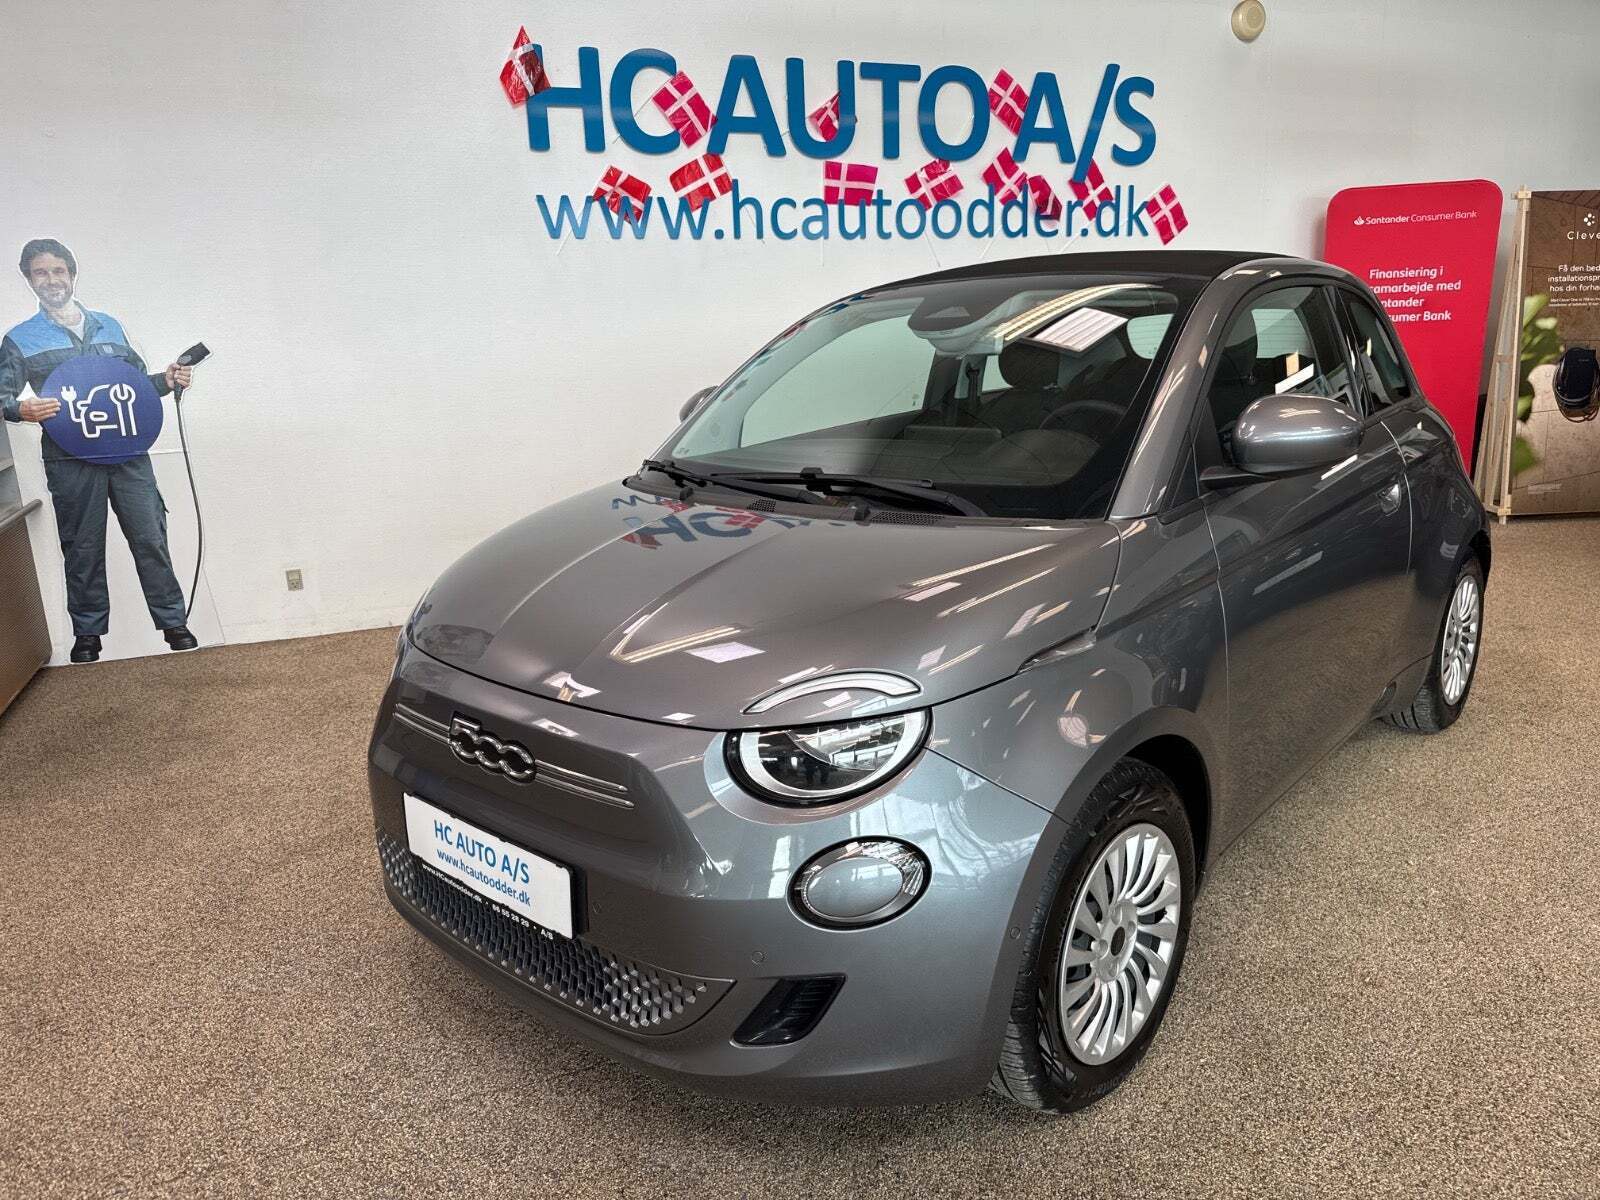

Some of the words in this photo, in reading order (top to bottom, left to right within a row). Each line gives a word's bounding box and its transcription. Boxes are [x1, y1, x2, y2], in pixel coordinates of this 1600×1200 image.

[525, 43, 681, 156] HC
[706, 54, 990, 162] AUTO
[1012, 63, 1157, 183] A/S
[536, 178, 1149, 240] www.hcautoodder.dk
[1365, 215, 1409, 226] Santander
[1410, 212, 1454, 223] Consumer
[1455, 210, 1478, 220] Bank
[1369, 266, 1437, 279] Finansiering
[1439, 265, 1444, 276] i
[1570, 264, 1585, 272] den
[1436, 280, 1462, 291] med
[1566, 284, 1578, 292] din
[1380, 297, 1425, 308] ntander
[1423, 310, 1452, 321] Bank
[450, 714, 534, 781] 500
[434, 819, 453, 846] HC
[456, 831, 497, 868] AUTO
[501, 854, 530, 884] A/S
[436, 848, 531, 907] www.hcautoodder.dk
